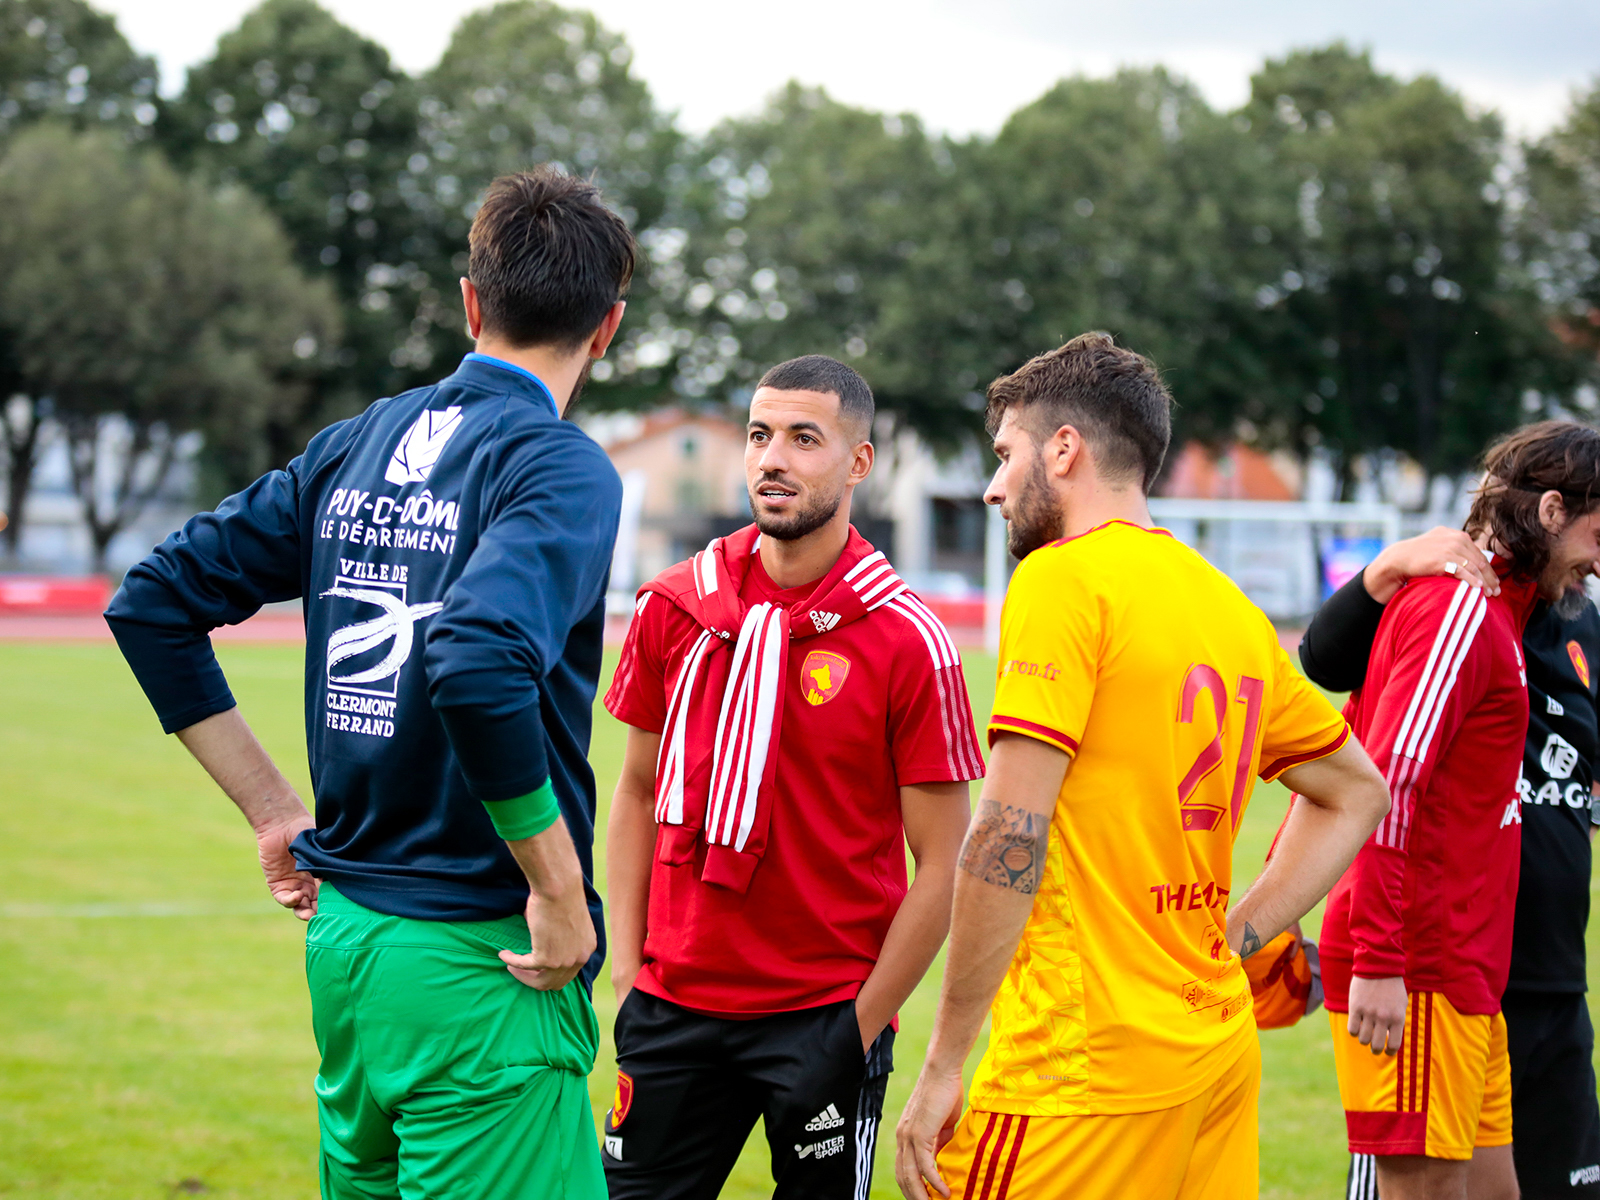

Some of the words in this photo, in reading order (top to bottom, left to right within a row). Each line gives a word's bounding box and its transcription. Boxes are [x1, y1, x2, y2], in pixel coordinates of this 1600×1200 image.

[320, 519, 335, 539] LE
[339, 557, 389, 581] VILLE
[391, 565, 409, 583] DE
[326, 692, 397, 718] CLERMONT
[326, 712, 395, 738] FERRAND
[1176, 662, 1265, 835] 21
[805, 1117, 845, 1131] adidas
[813, 1135, 845, 1152] INTER
[814, 1143, 845, 1160] SPORT
